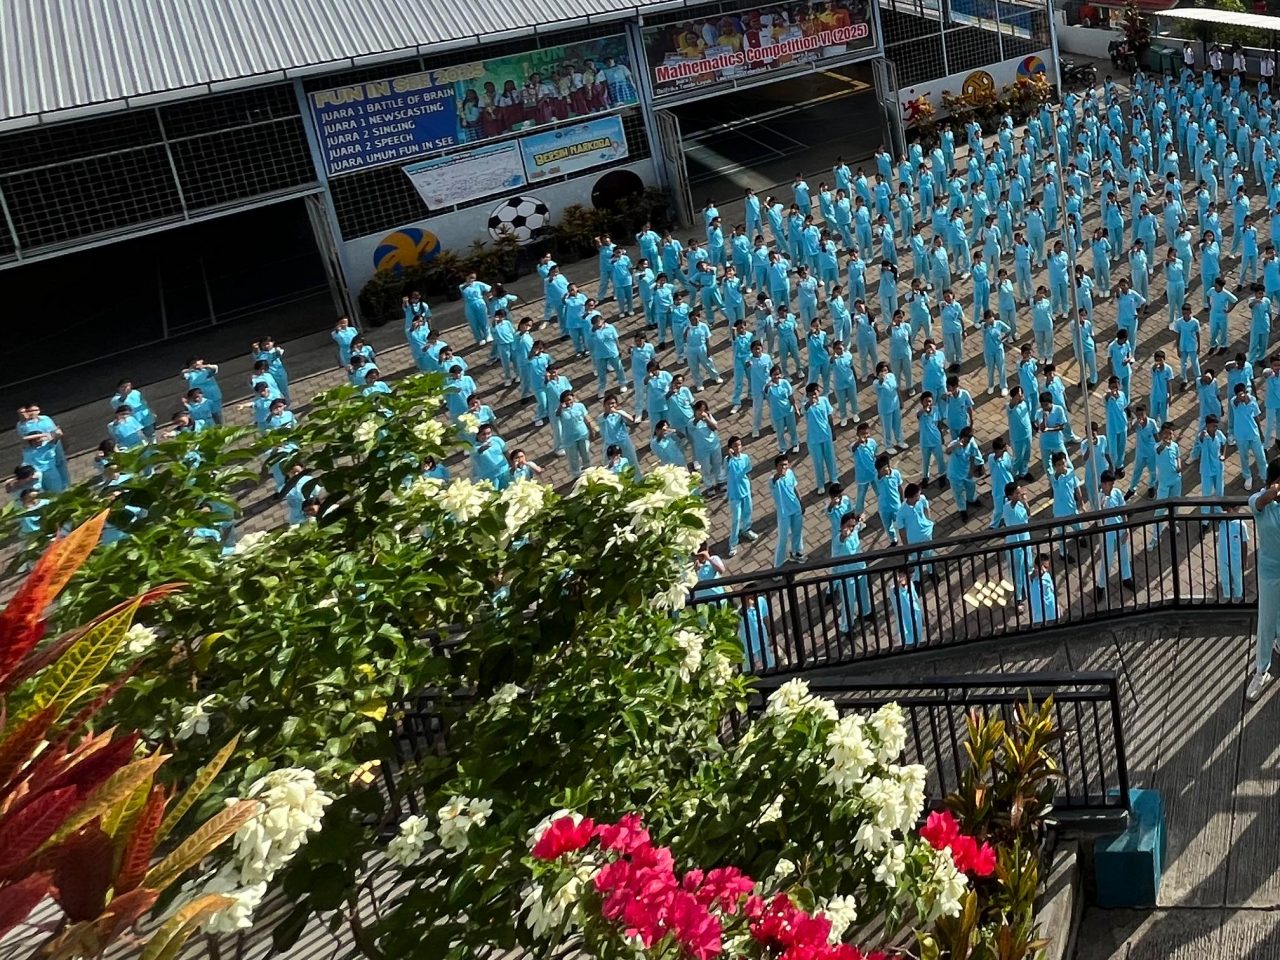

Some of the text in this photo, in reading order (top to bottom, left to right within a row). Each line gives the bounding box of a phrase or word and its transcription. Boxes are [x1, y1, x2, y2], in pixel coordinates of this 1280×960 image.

[655, 51, 744, 83] Mathematics
[746, 32, 818, 63] Competition
[819, 30, 831, 47] VI
[832, 22, 869, 45] (2025)
[314, 86, 364, 108] FUN
[367, 81, 391, 98] IN
[393, 74, 432, 93] SEE
[322, 88, 455, 123] JUARA 1 BATTLE OF BRAIN
[324, 102, 444, 136] JUARA 1 NEWSCASTING
[326, 120, 416, 148] JUARA 2 SINGING
[329, 133, 414, 160] JUARA 2 SPEECH
[330, 158, 363, 173] JUARA
[366, 149, 397, 162] UMUM
[400, 144, 419, 157] FUN
[422, 141, 433, 150] IN
[436, 136, 455, 147] SEE
[534, 146, 569, 167] BERSIH
[569, 137, 611, 155] NARKOBA
